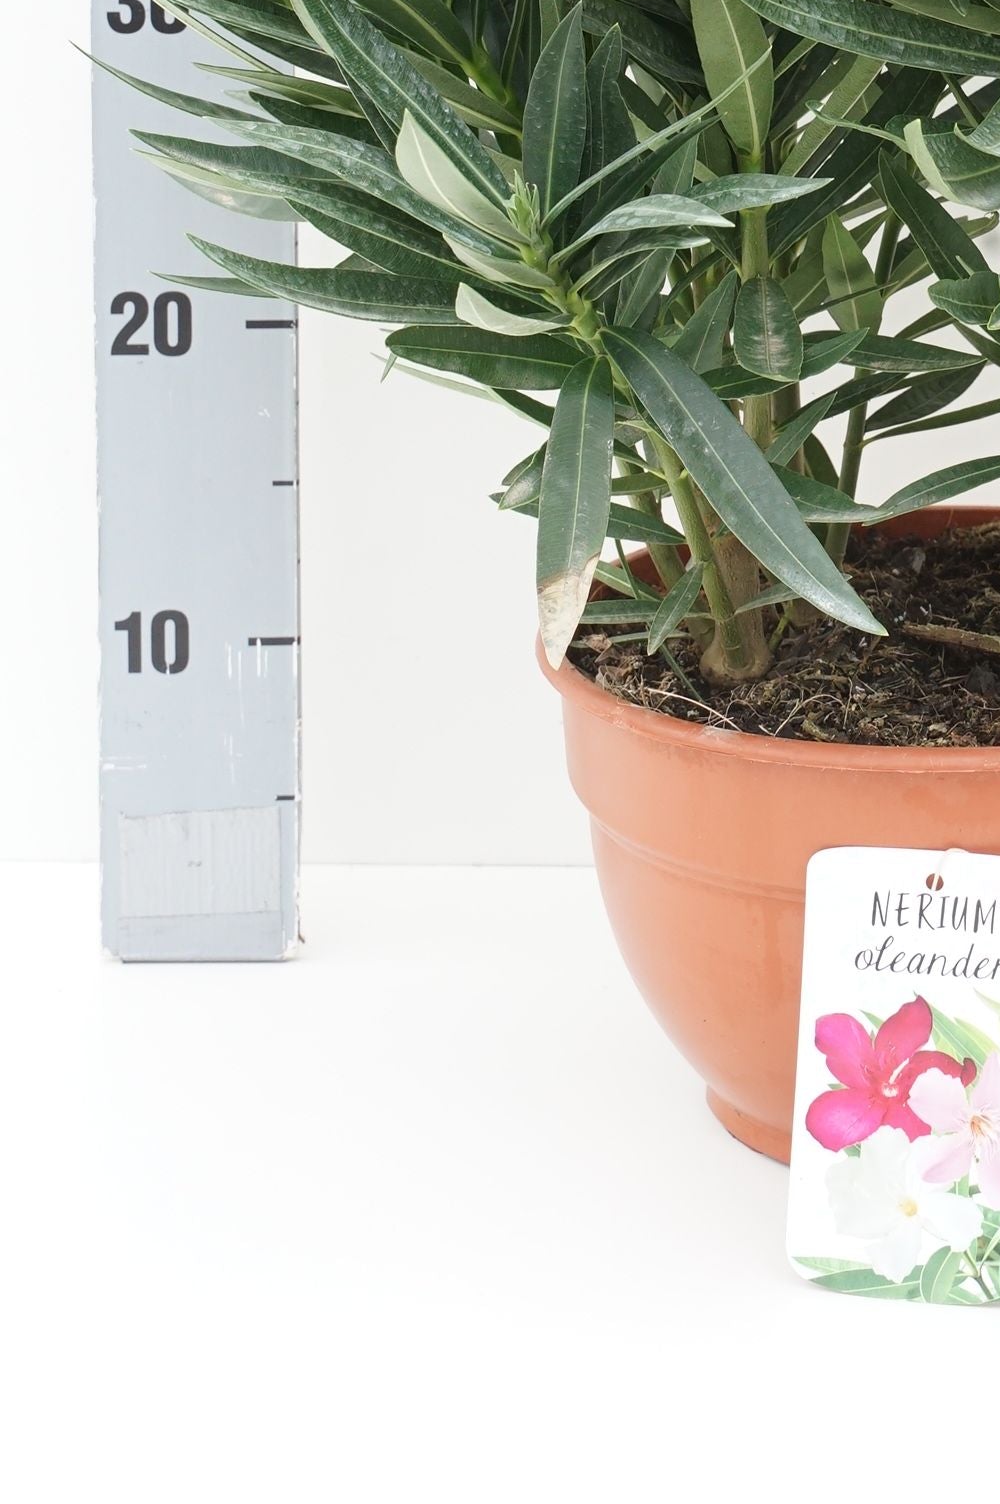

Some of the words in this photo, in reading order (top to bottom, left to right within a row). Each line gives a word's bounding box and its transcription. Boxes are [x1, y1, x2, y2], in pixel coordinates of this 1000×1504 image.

[110, 290, 193, 357] 20
[114, 610, 190, 674] 10
[871, 890, 997, 935] NERIUM
